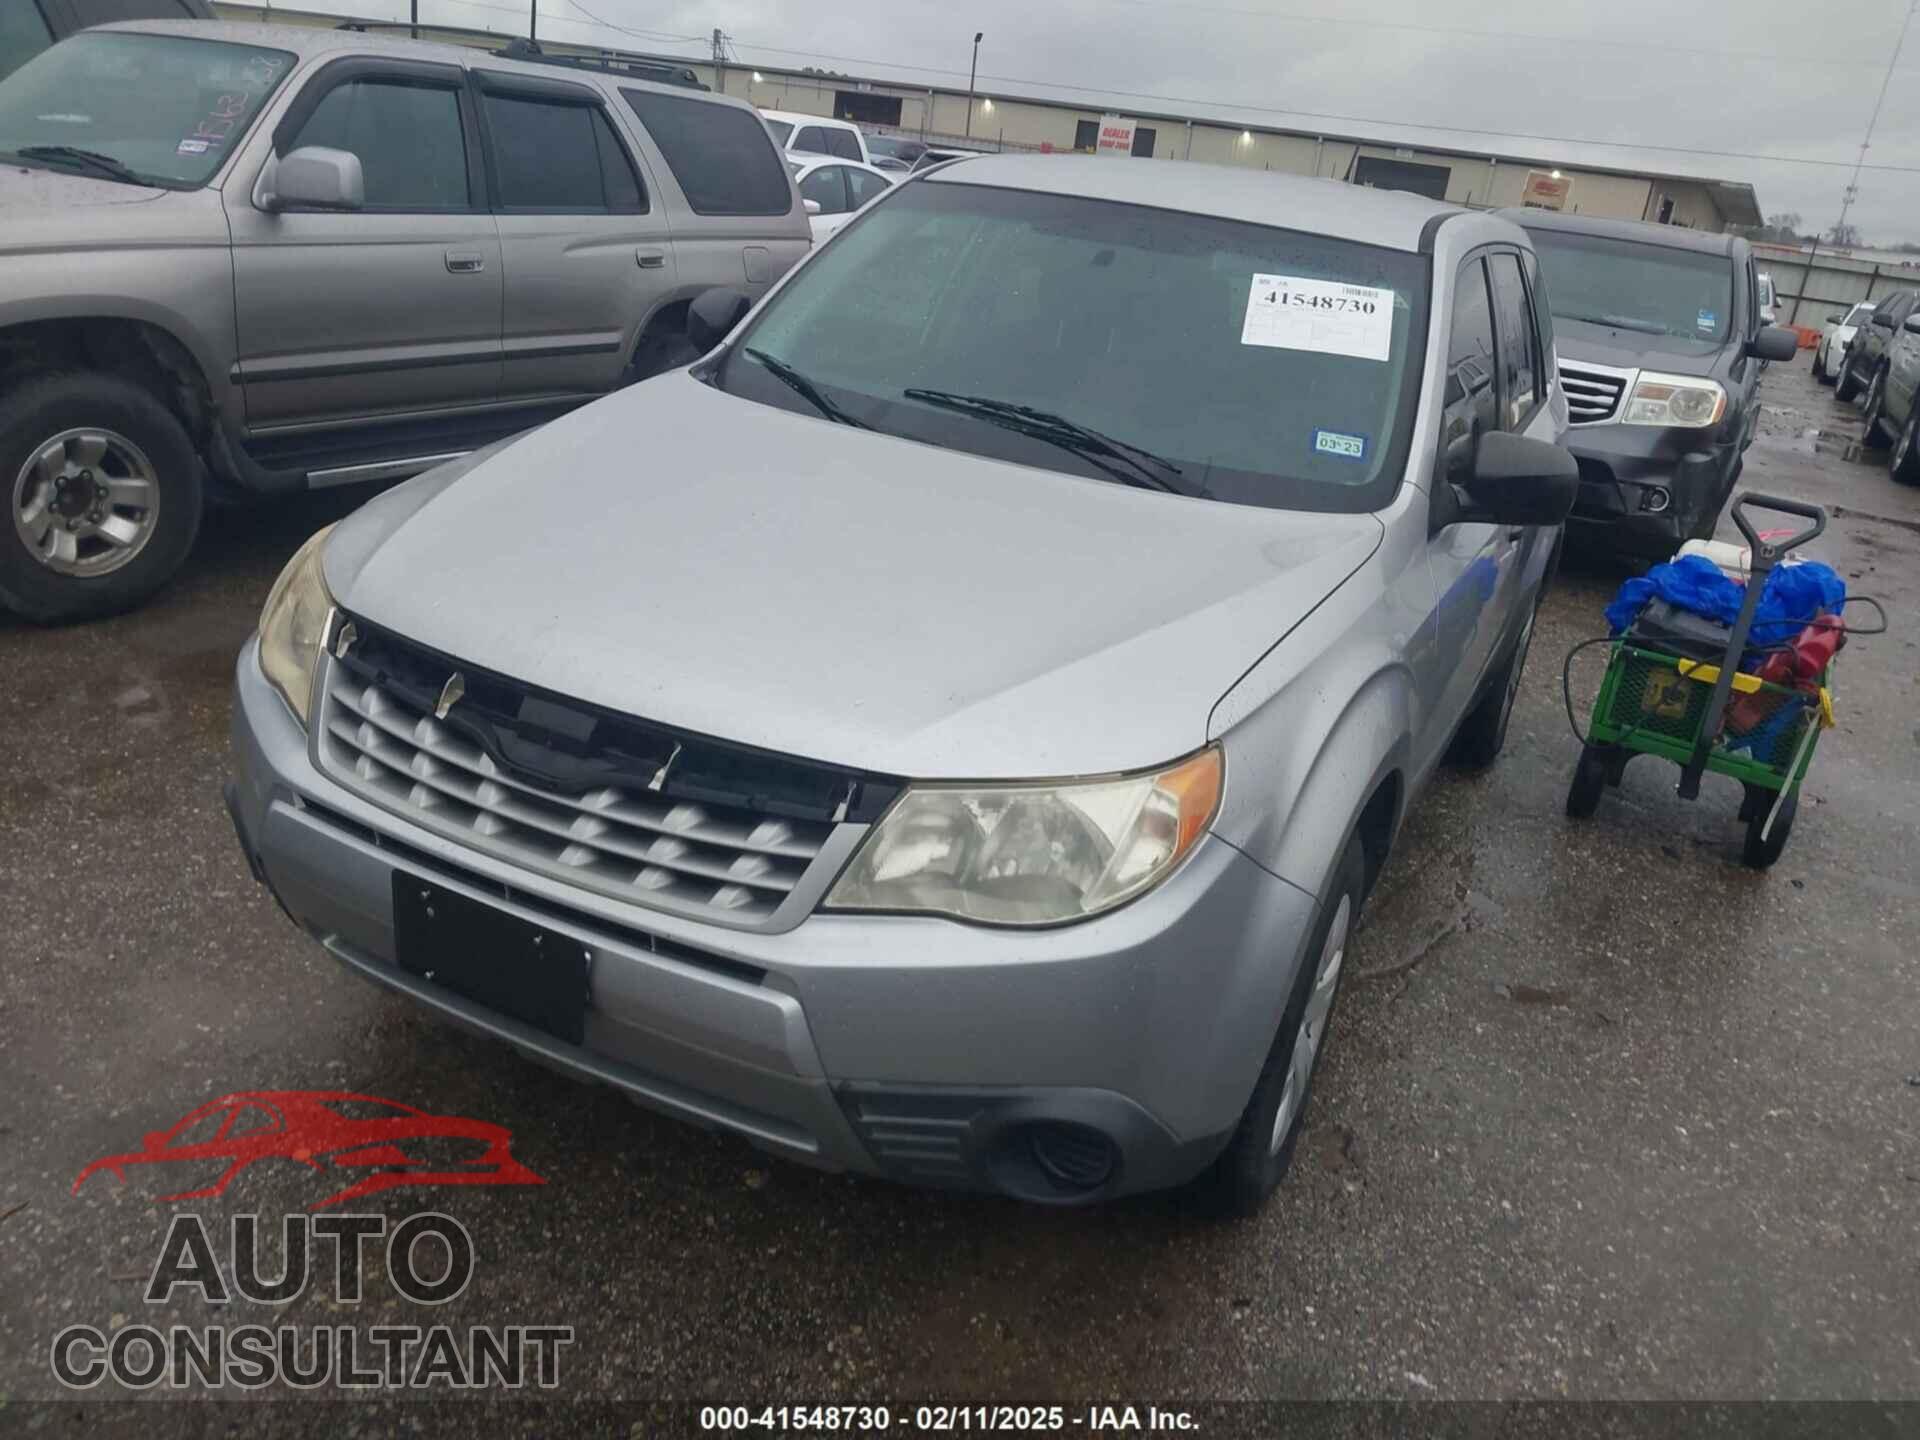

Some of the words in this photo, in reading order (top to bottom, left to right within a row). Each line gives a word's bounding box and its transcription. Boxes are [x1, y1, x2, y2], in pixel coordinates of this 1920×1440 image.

[1264, 291, 1376, 315] 41548730
[1319, 438, 1336, 449] 03
[1344, 442, 1361, 454] 23
